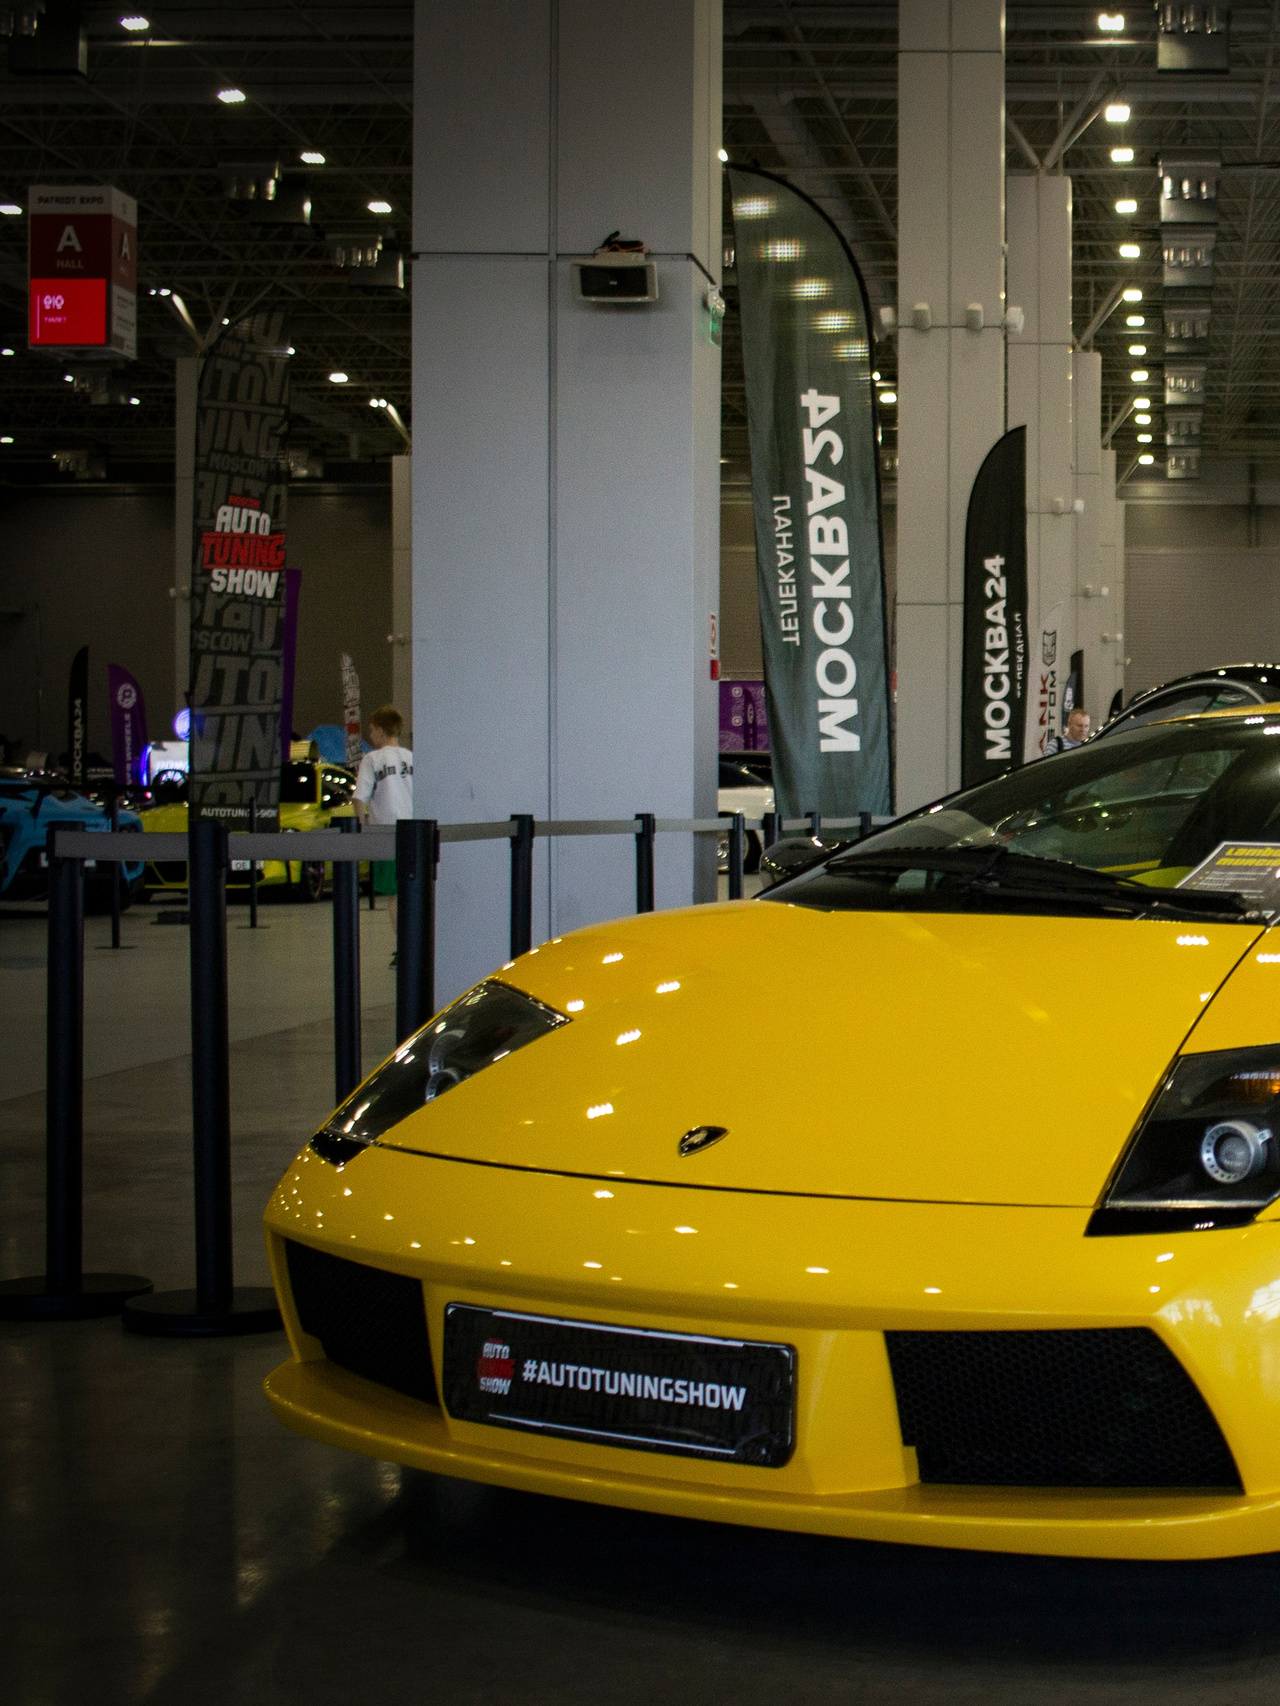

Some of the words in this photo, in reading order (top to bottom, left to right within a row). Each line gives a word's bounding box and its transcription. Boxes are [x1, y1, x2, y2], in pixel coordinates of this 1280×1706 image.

[80, 196, 103, 204] EXPO
[56, 224, 82, 253] A
[56, 259, 84, 269] HALL
[215, 505, 271, 535] AUTO
[202, 535, 285, 568] TUNING
[211, 568, 279, 599] SHOW
[984, 555, 1011, 761] МОСКВА24
[482, 1342, 511, 1359] AUTO
[479, 1377, 512, 1396] SHOW
[522, 1360, 746, 1411] #AUTOTUNINGSHOW
